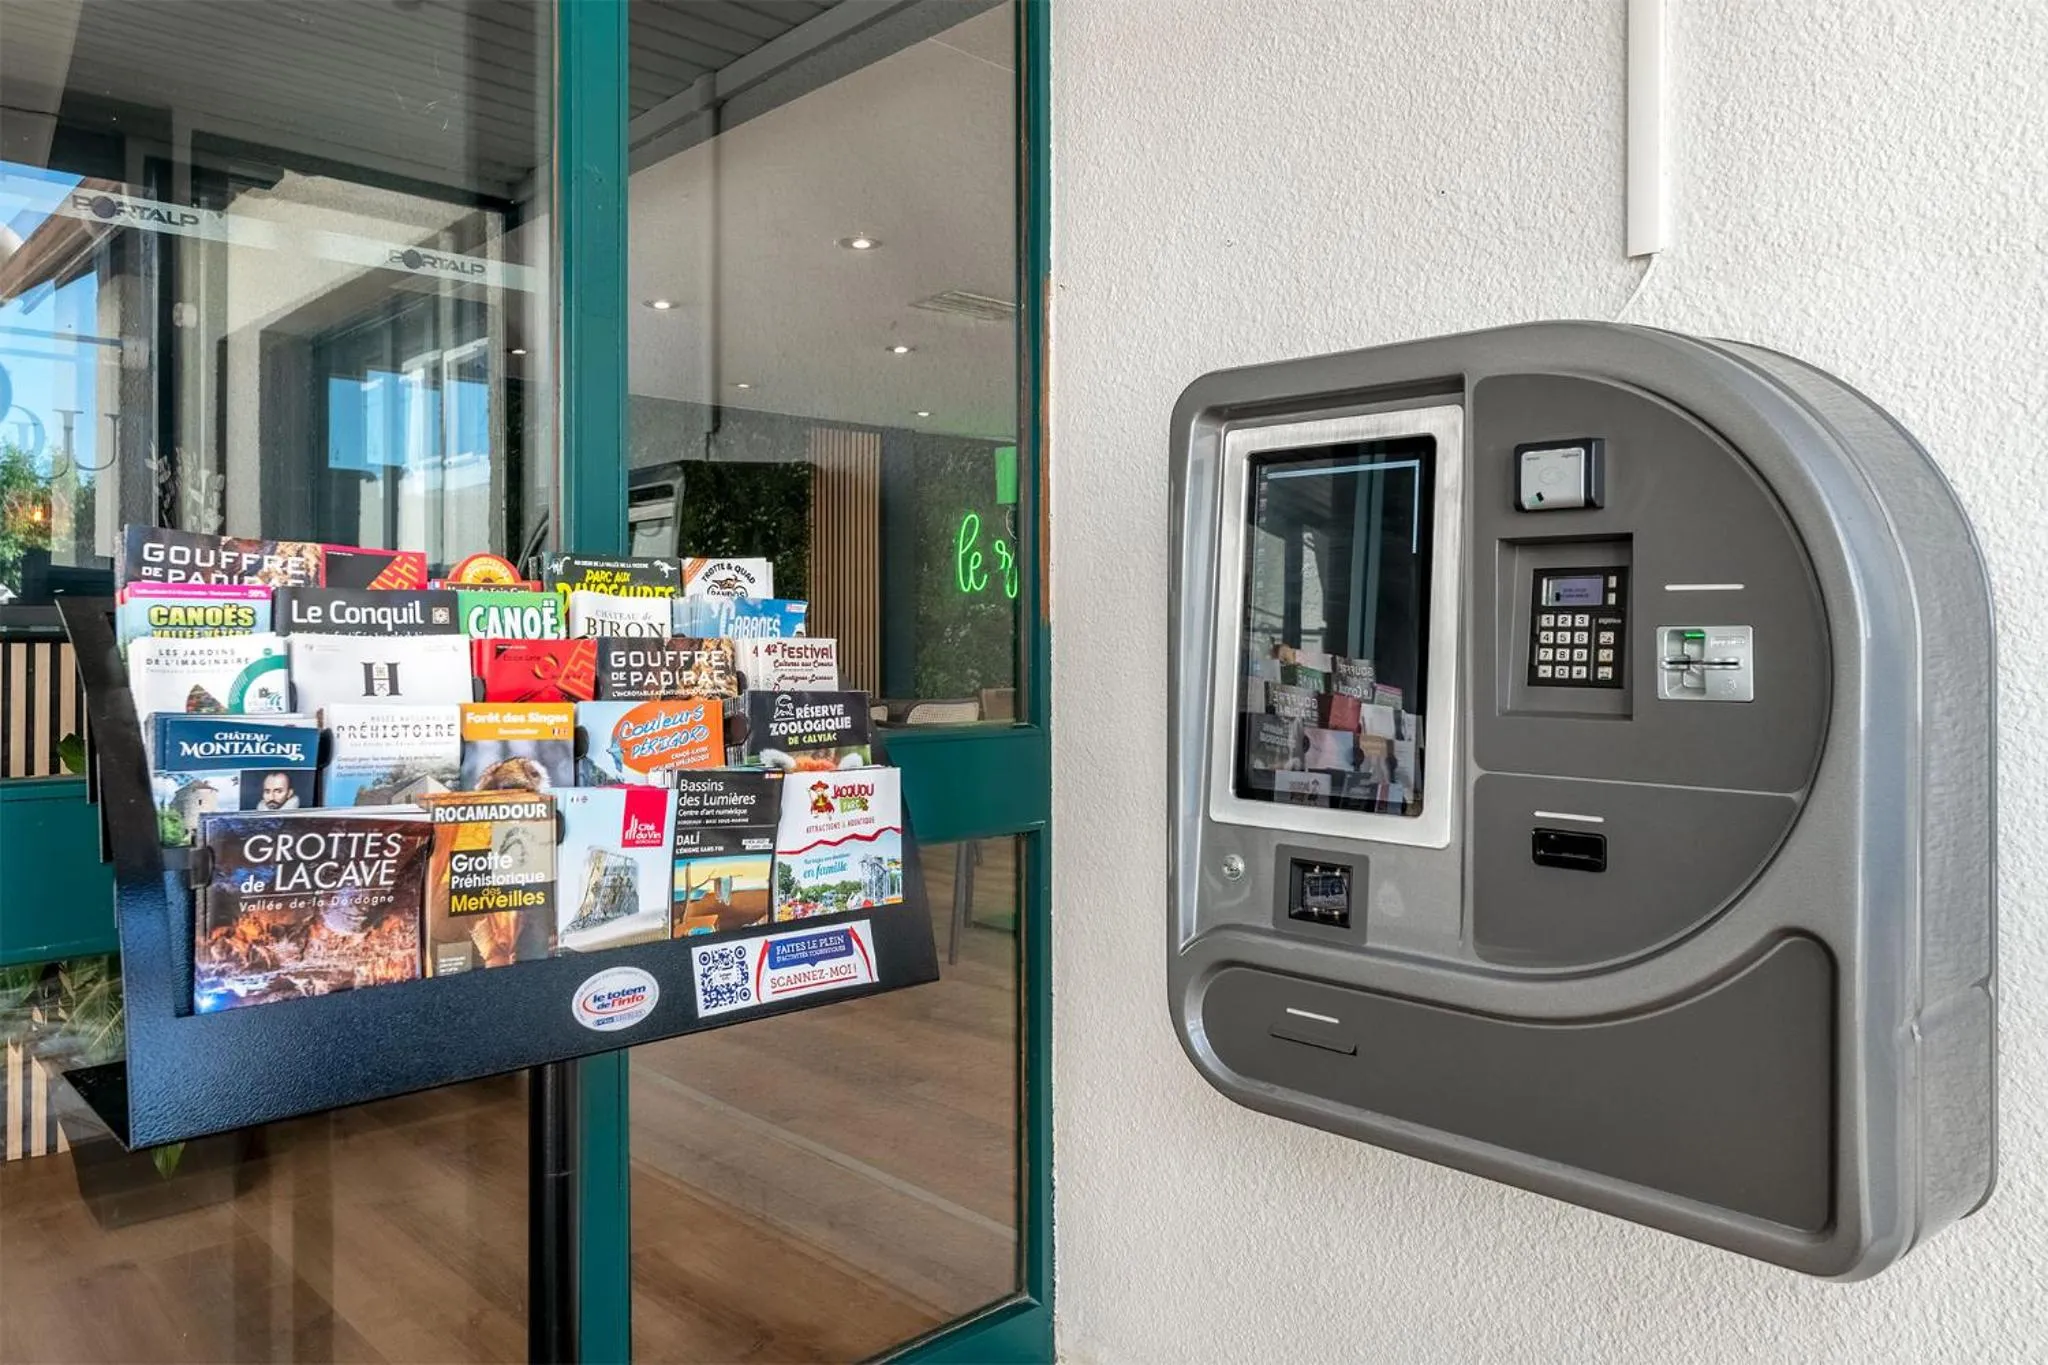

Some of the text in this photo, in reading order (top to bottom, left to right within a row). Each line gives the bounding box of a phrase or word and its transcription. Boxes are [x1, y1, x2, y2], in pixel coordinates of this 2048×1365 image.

[143, 543, 306, 576] GOUFFRE
[958, 513, 988, 592] le
[142, 566, 306, 587] DE PADI
[585, 568, 632, 584] PARC AUX
[701, 563, 725, 582] TROTTE
[734, 564, 756, 585] QUAD
[149, 603, 257, 628] CANOËS
[292, 600, 425, 631] Le Conquil
[468, 600, 559, 639] CANOË
[585, 617, 665, 637] BIRON
[146, 658, 160, 666] DE
[159, 648, 236, 657] LES JARDINS
[610, 650, 726, 667] GOUFFRE
[611, 670, 726, 687] DE PADIRAC
[502, 711, 526, 724] des
[796, 703, 844, 719] RÉSERVE
[336, 721, 457, 740] PRÉHISTOIRE
[619, 704, 704, 740] Couleurs
[769, 716, 852, 737] ZOOLOGIQUE
[788, 732, 837, 745] DE CALVIAC
[179, 741, 305, 760] MONTAIGNE
[680, 778, 725, 792] Bassins
[831, 783, 875, 799] JACQUOU
[679, 793, 756, 806] des Lumières
[435, 803, 547, 822] ROCAMADOUR
[678, 808, 748, 817] Centre d'art numérique
[243, 832, 402, 863] GROTTES
[451, 852, 513, 873] Grotte
[815, 860, 847, 879] famille
[241, 859, 398, 893] de LACAVE
[451, 871, 546, 890] Préhistorique
[451, 890, 546, 912] Merveilles
[482, 886, 501, 897] des
[239, 900, 282, 912] Vallée
[290, 898, 305, 909] de
[331, 894, 394, 907] Dordogne
[776, 935, 844, 955] FAITES LE PLEIN
[593, 985, 646, 1003] le totem
[596, 994, 644, 1010] de l'info
